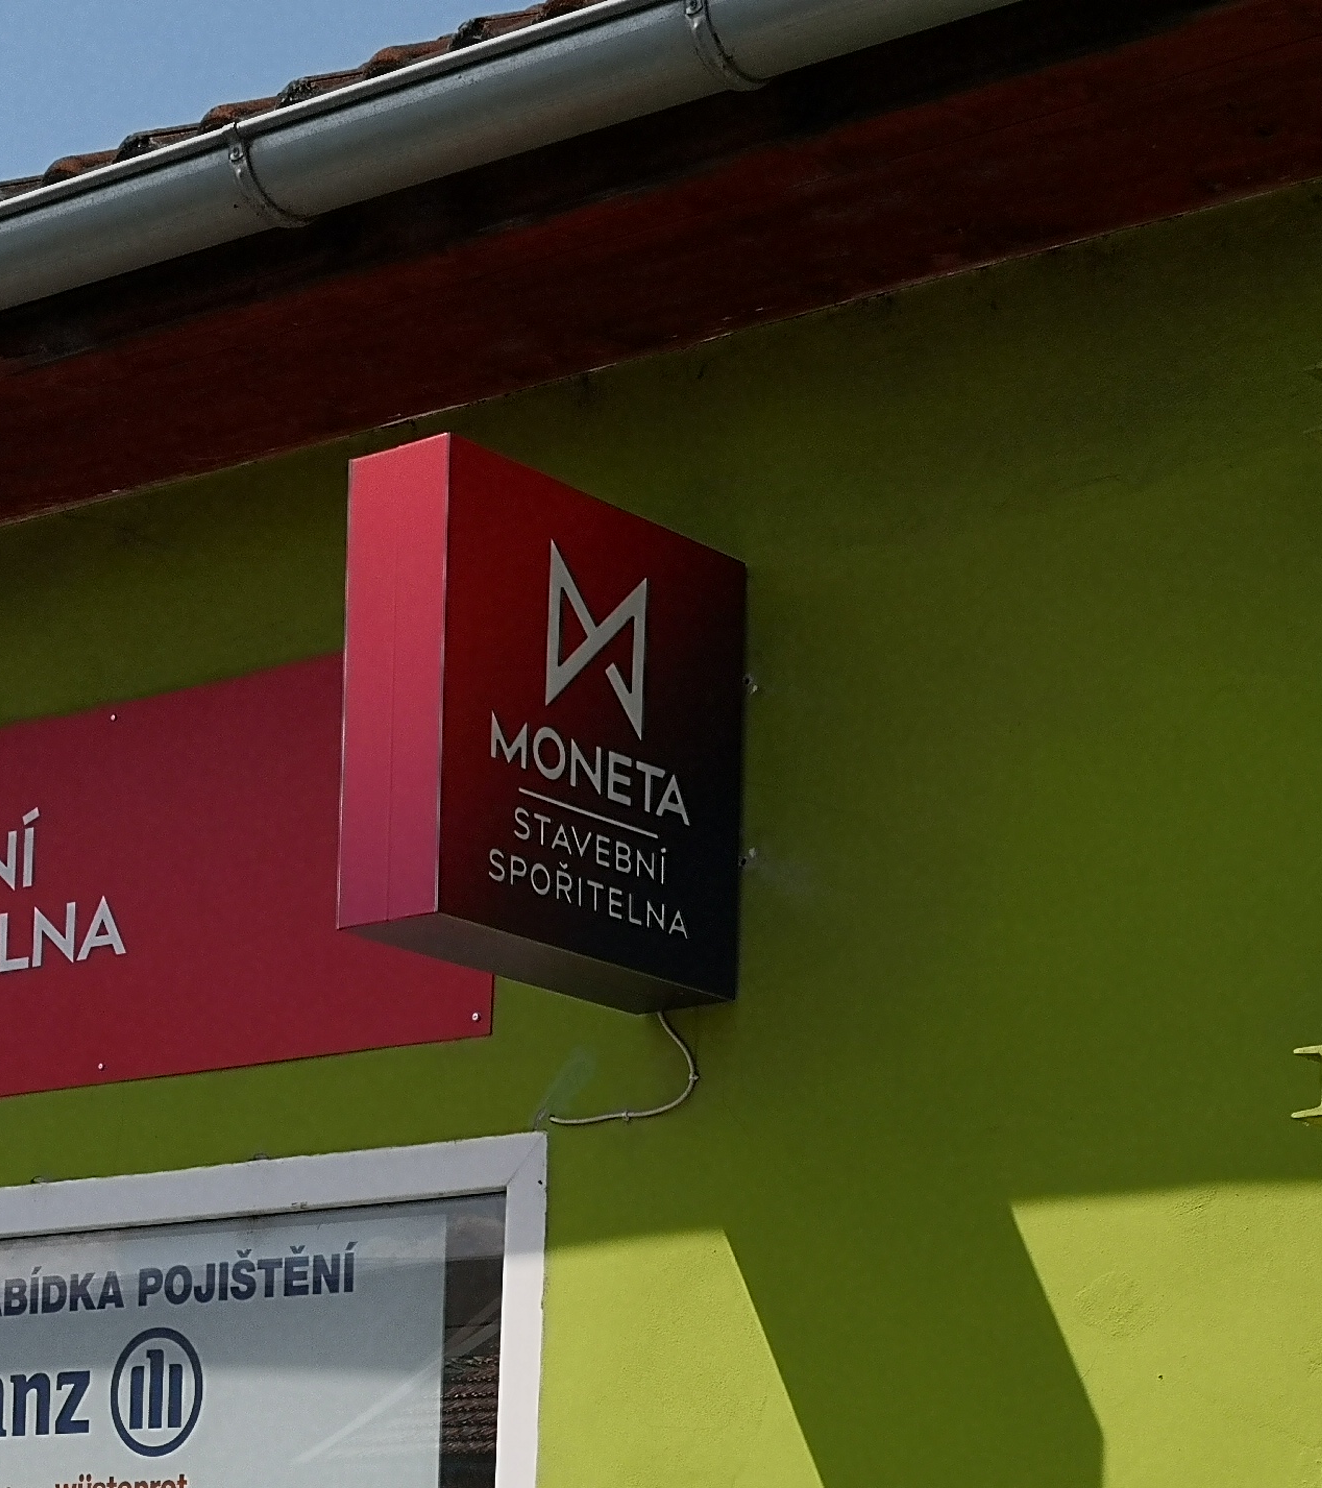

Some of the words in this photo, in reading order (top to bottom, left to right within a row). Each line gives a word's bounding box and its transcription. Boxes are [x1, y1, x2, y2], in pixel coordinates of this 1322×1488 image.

[490, 710, 690, 826] MONETA
[514, 807, 667, 885] STAVEBNÍ
[488, 848, 689, 939] SPOŘITELNA
[138, 1242, 358, 1306] POJIŠTĚNÍ
